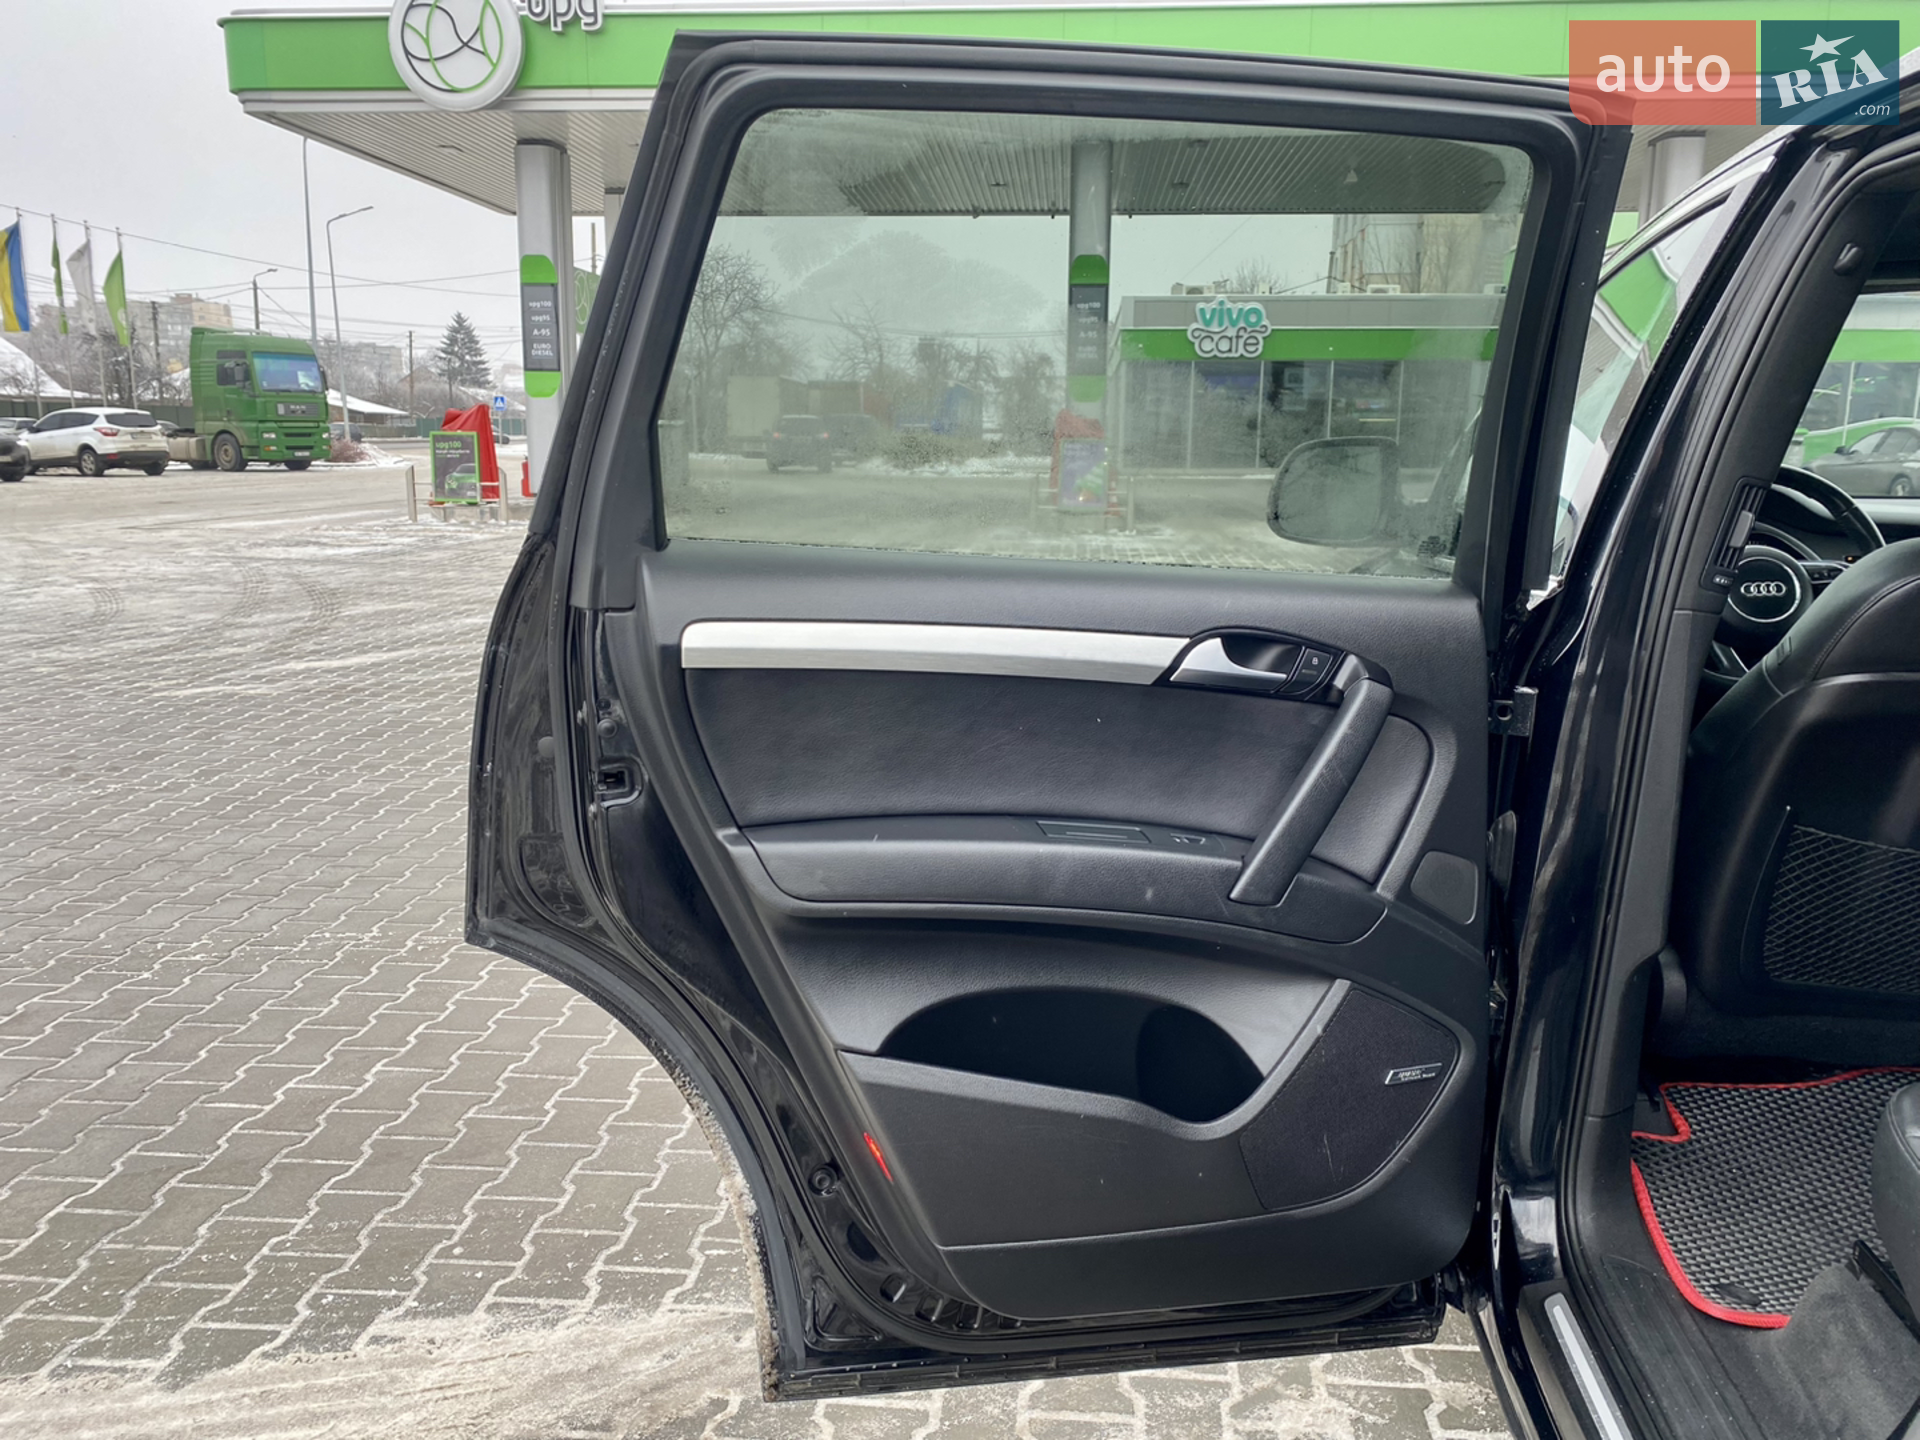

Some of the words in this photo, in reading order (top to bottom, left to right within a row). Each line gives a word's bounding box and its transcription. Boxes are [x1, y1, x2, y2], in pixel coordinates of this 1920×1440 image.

[1199, 300, 1263, 328] vivo
[532, 328, 551, 336] A-95
[435, 441, 462, 449] upg100
